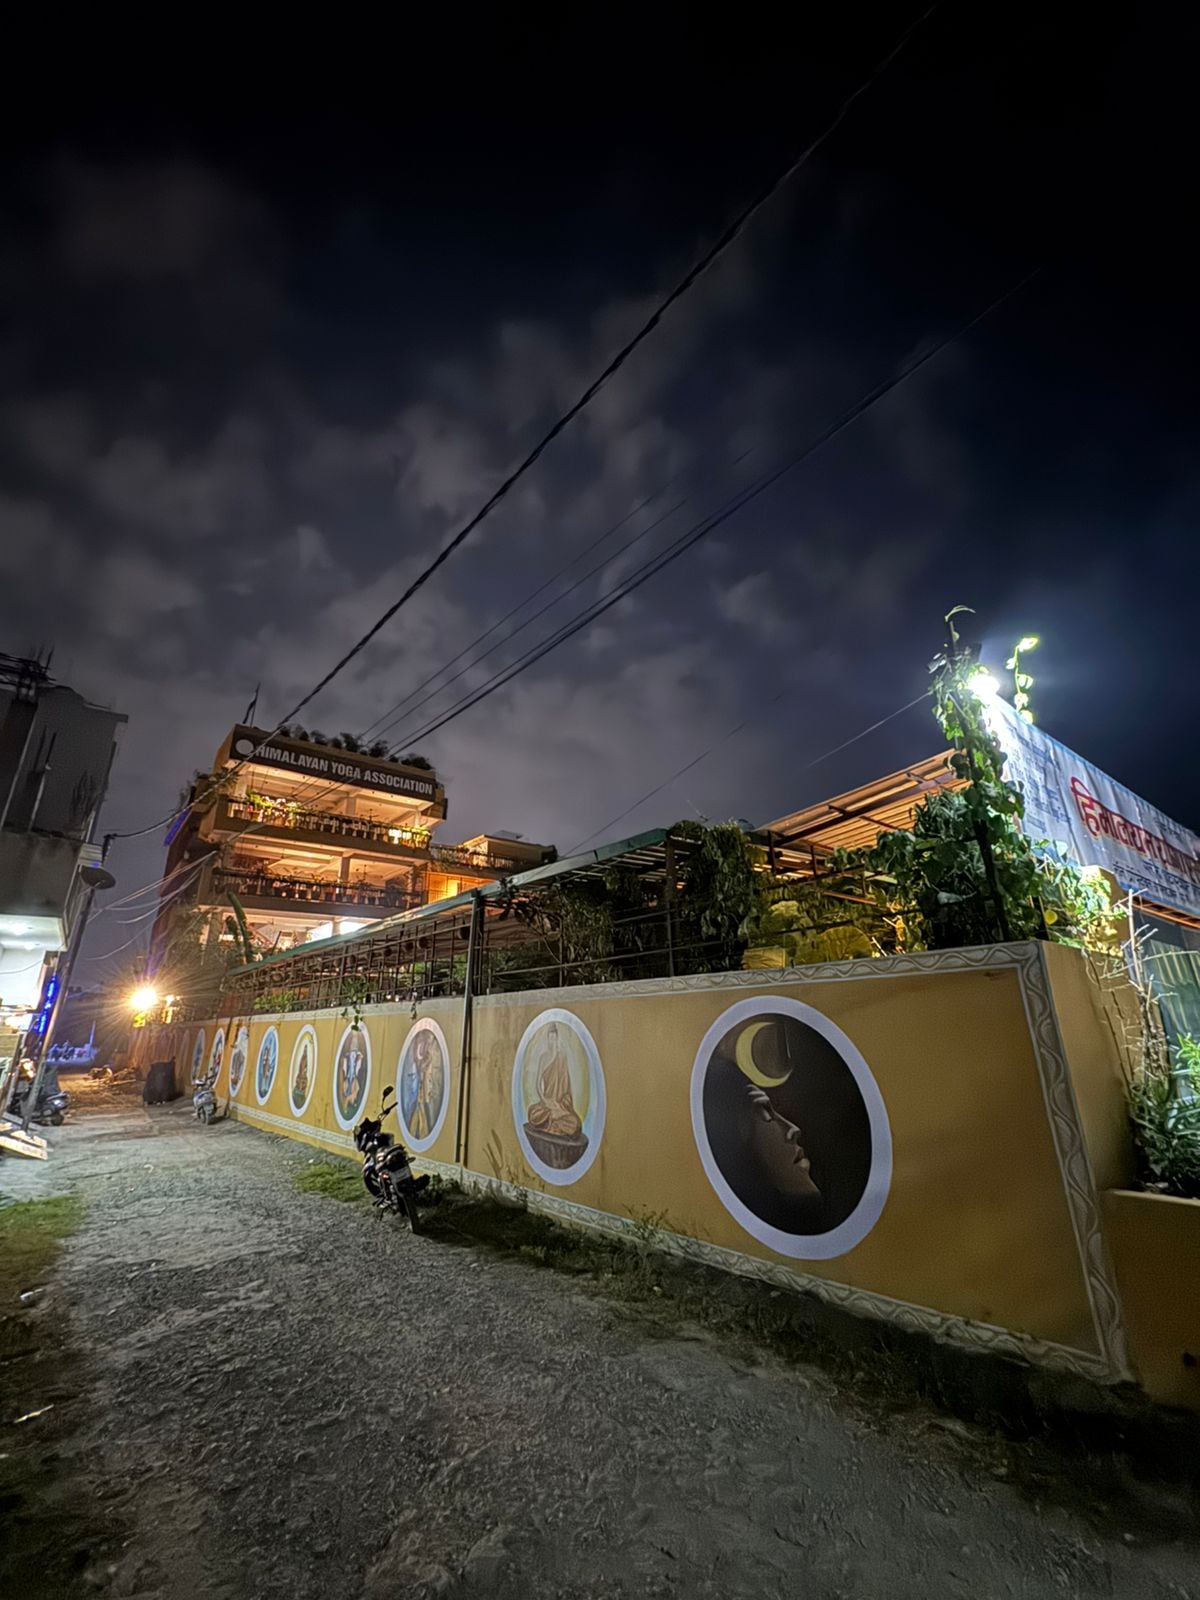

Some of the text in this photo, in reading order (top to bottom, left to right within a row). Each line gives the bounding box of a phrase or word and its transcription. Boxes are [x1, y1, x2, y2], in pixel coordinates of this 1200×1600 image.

[256, 745, 432, 795] HIMALAYAN YOGA ASSOCIATION
